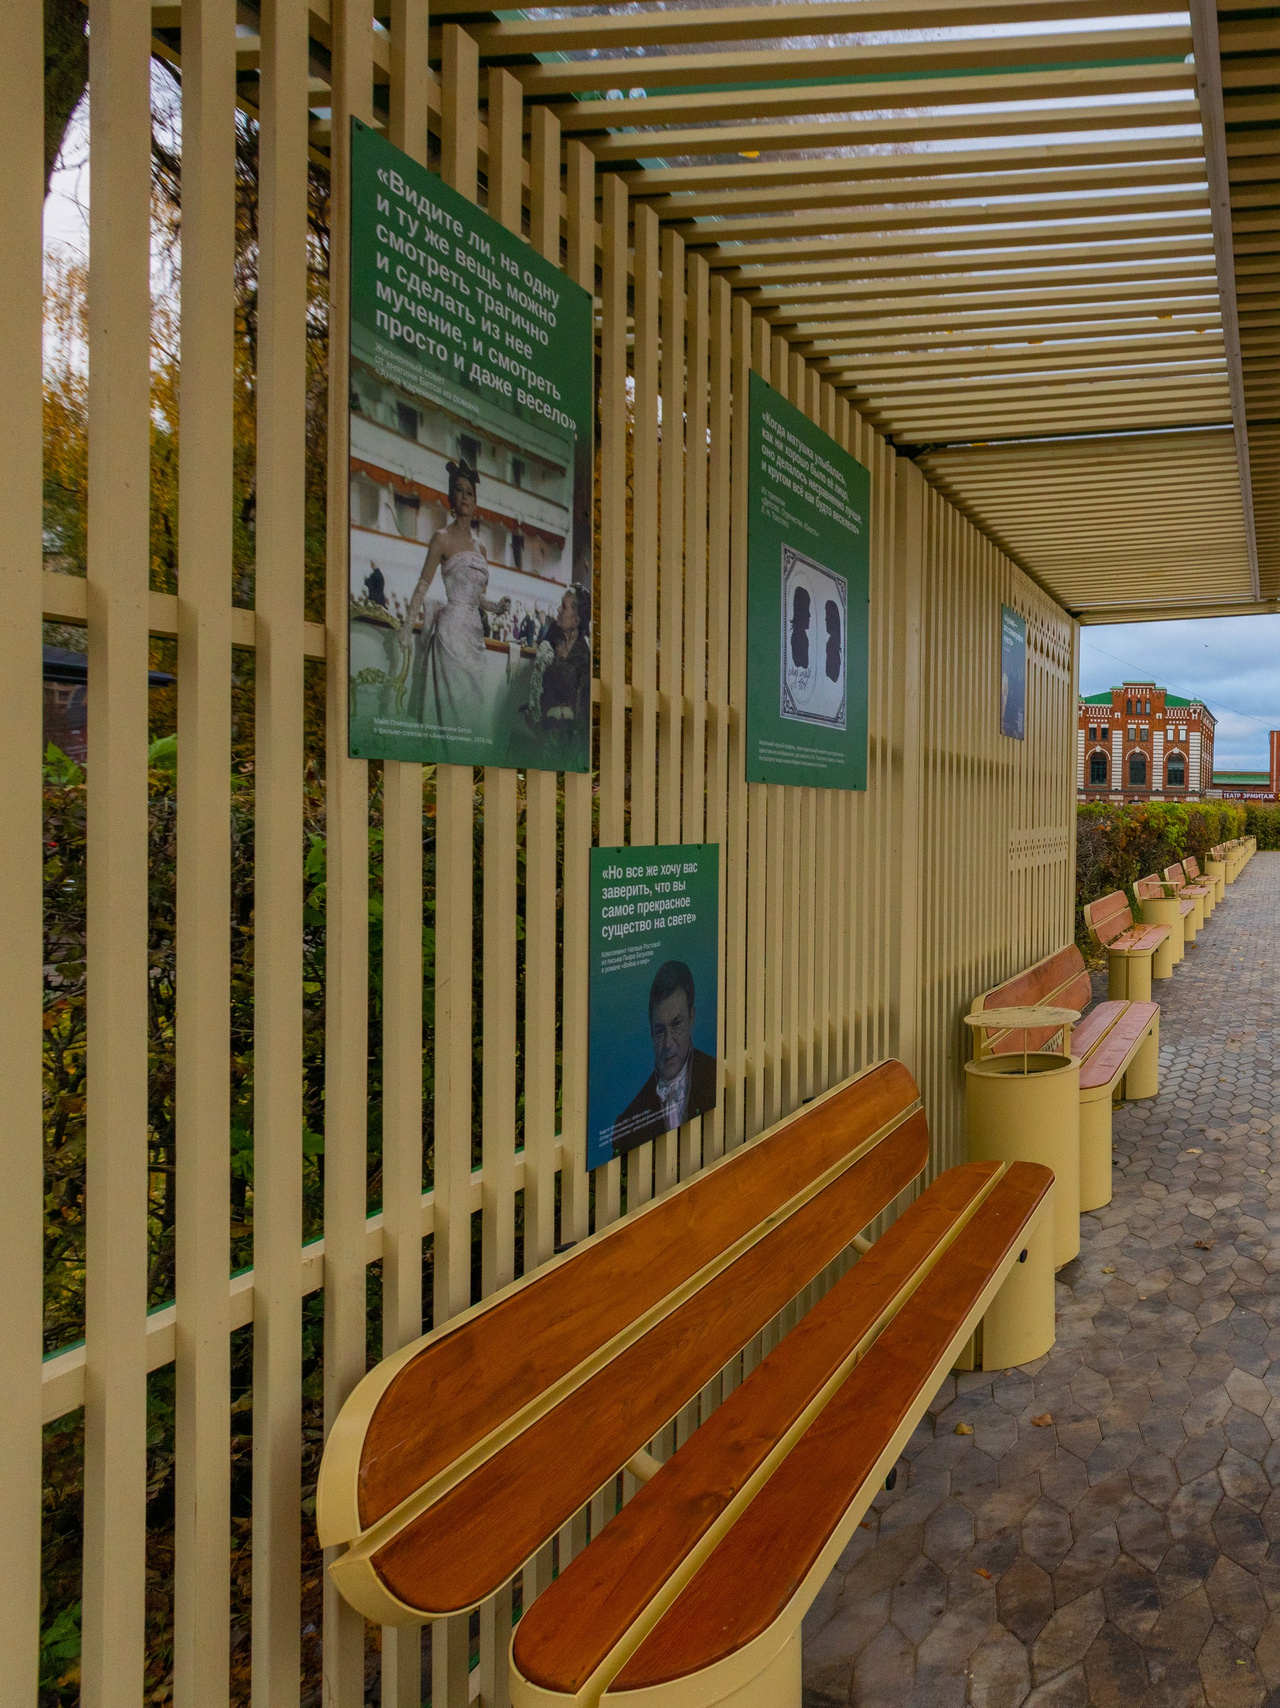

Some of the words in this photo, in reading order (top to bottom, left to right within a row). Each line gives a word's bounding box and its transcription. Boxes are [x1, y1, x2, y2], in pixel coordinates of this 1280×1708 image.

[377, 168, 463, 238] «Видите
[468, 231, 495, 265] ли,
[501, 253, 520, 279] на
[524, 271, 559, 308] одну
[377, 194, 389, 217] и
[396, 206, 419, 238] ту
[424, 226, 449, 255] же
[455, 247, 502, 290] вещь
[507, 283, 556, 327] можно
[376, 224, 470, 295] смотреть
[475, 287, 548, 346] трагично
[377, 251, 389, 274] и
[396, 265, 476, 325] сделать
[481, 316, 500, 340] из
[505, 331, 532, 359] нее
[377, 280, 467, 350] мучение,
[473, 337, 483, 356] и
[488, 347, 561, 400] смотреть
[376, 309, 448, 361] просто
[454, 352, 464, 371] и
[469, 362, 512, 397] даже
[517, 388, 576, 430] весело»
[762, 412, 786, 439] «Когда
[787, 431, 814, 460] матушка
[762, 428, 774, 444] как
[775, 438, 784, 452] ни
[785, 445, 809, 470] хорошо
[810, 461, 826, 483] было
[762, 444, 775, 461] оно
[776, 454, 807, 484] делалось
[762, 461, 766, 471] и
[768, 465, 791, 488] кругом
[804, 490, 815, 505] как
[816, 496, 832, 517] будто
[602, 865, 623, 879] «Но
[626, 866, 643, 878] все
[646, 865, 658, 876] же
[661, 864, 681, 877] хочу
[683, 863, 698, 873] вас
[602, 884, 652, 900] заверить,
[655, 882, 670, 893] что
[673, 881, 686, 891] вы
[602, 904, 634, 918] самое
[637, 897, 690, 916] прекрасное
[602, 920, 652, 940] существо
[654, 918, 665, 929] на
[667, 914, 696, 926] свете»
